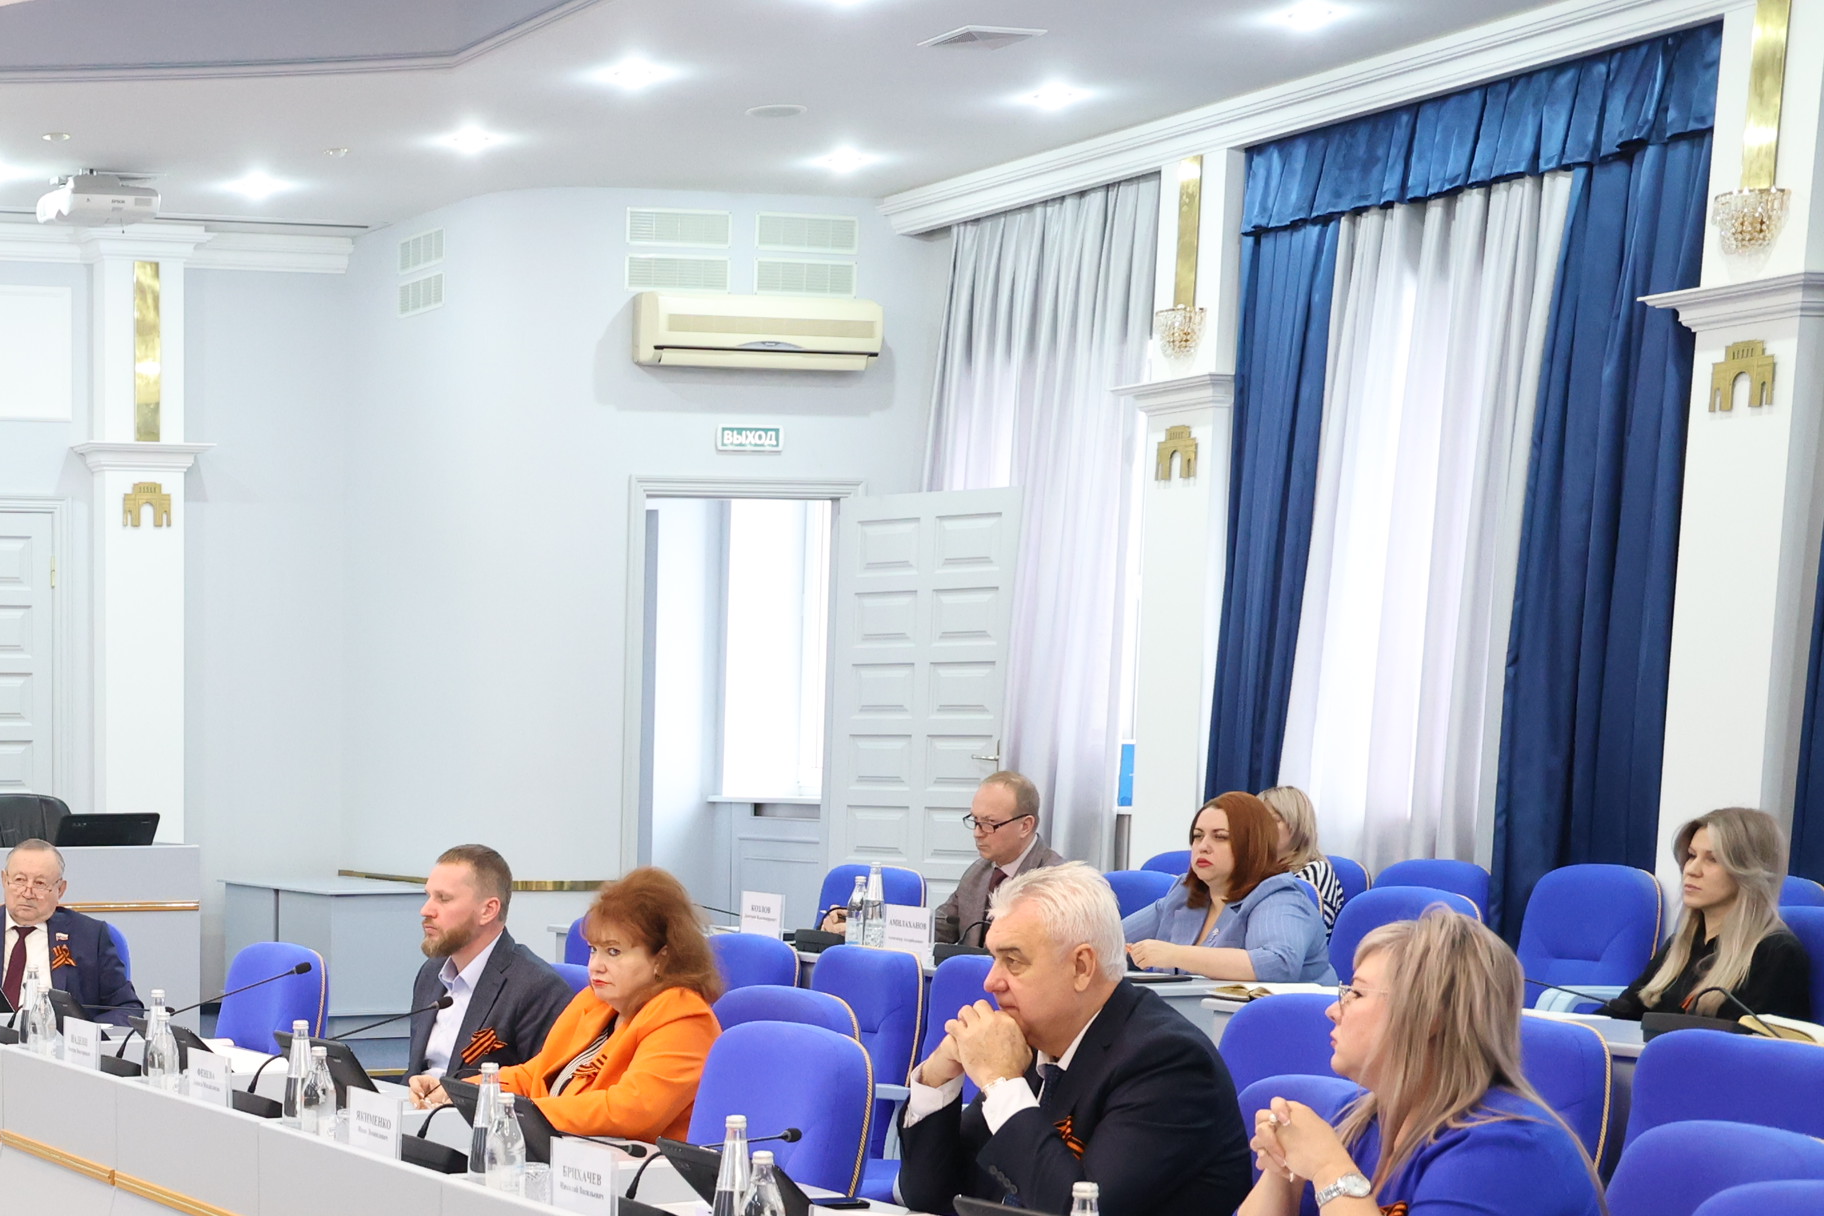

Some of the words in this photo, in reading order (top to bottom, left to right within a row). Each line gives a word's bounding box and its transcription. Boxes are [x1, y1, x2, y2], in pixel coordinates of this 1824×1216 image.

[723, 430, 777, 446] ВЫХОД
[356, 1110, 391, 1130] ЯКИМЕНКО
[562, 1165, 602, 1186] БРИХАЧЕВ
